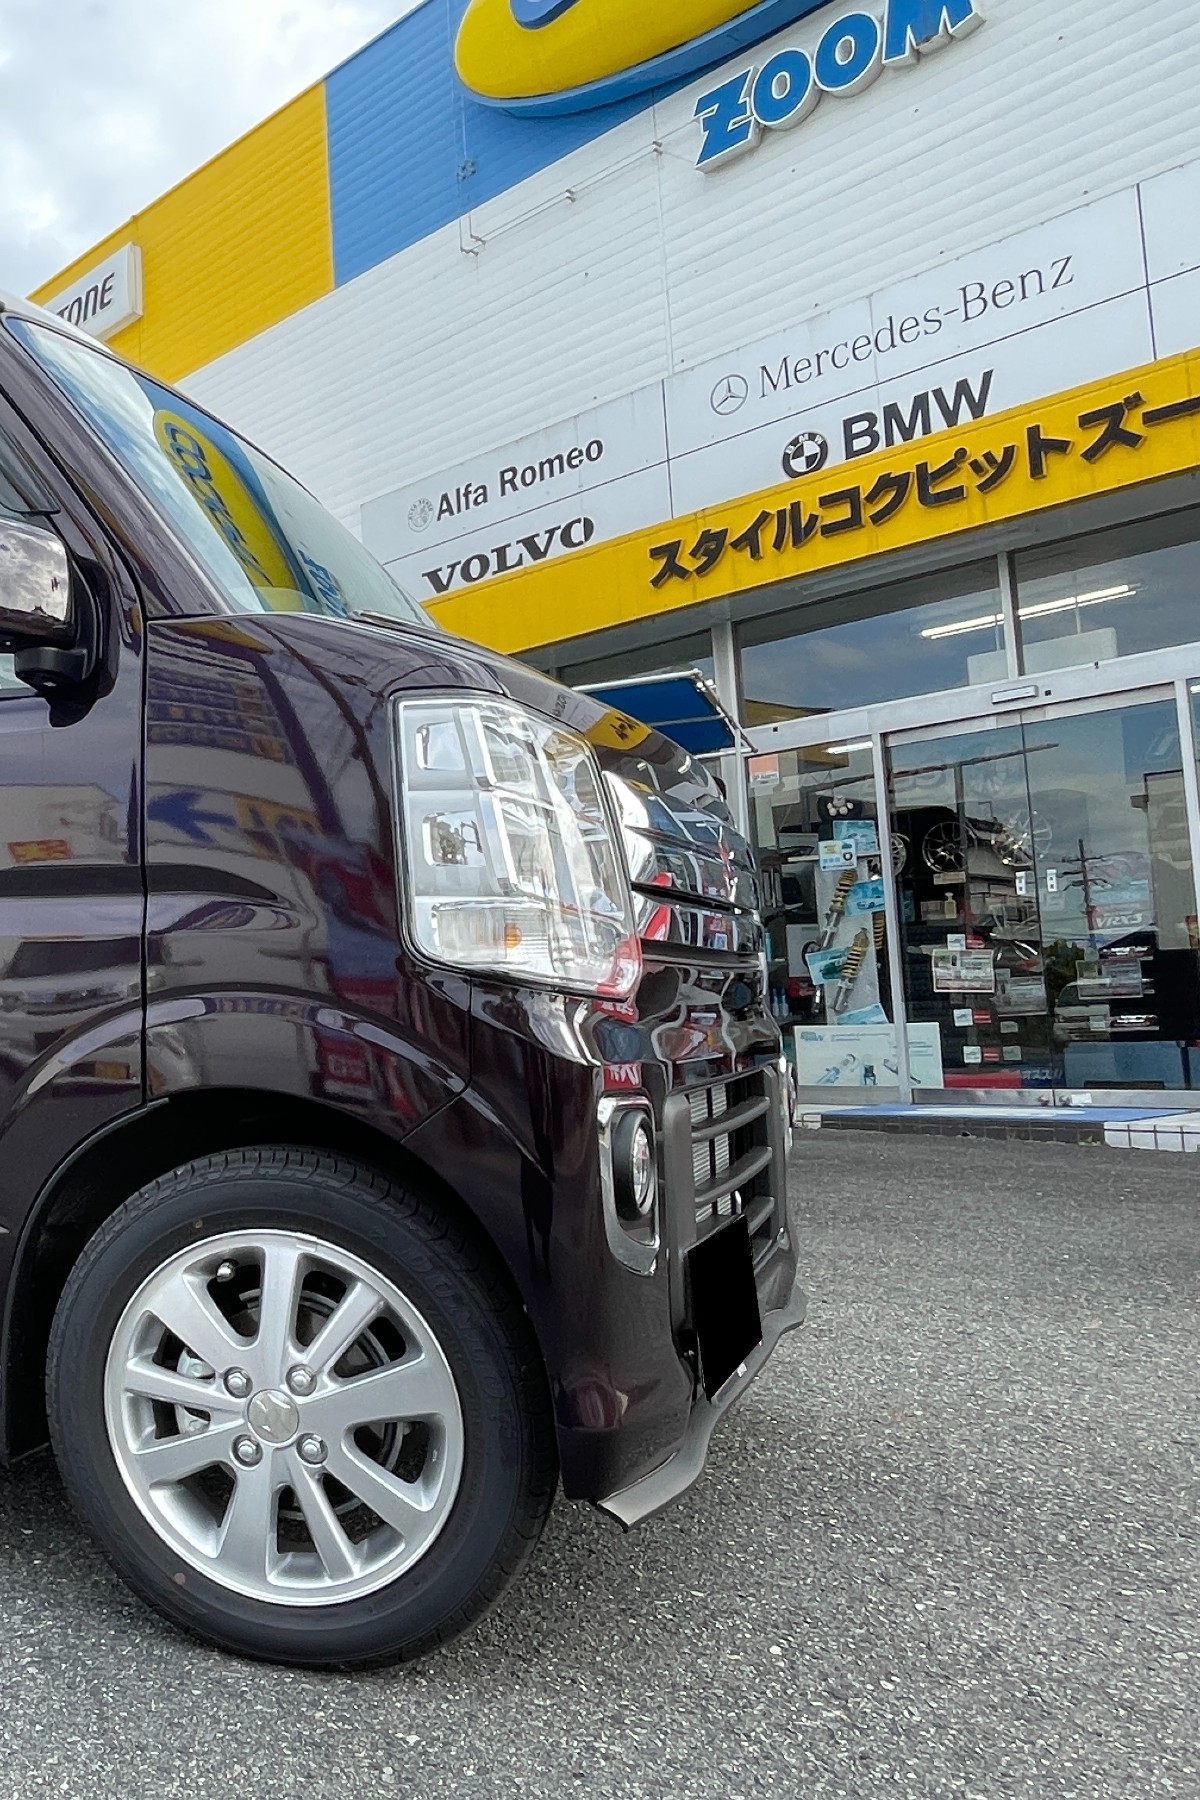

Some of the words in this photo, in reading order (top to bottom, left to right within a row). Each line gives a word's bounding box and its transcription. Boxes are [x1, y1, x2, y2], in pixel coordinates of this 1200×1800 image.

[693, 0, 976, 169] ZOOM
[758, 254, 1075, 399] Mercedes-Benz
[842, 368, 994, 461] BMW
[436, 482, 489, 521] Alfa
[499, 439, 604, 497] Romeo
[421, 516, 595, 595] VOLVO
